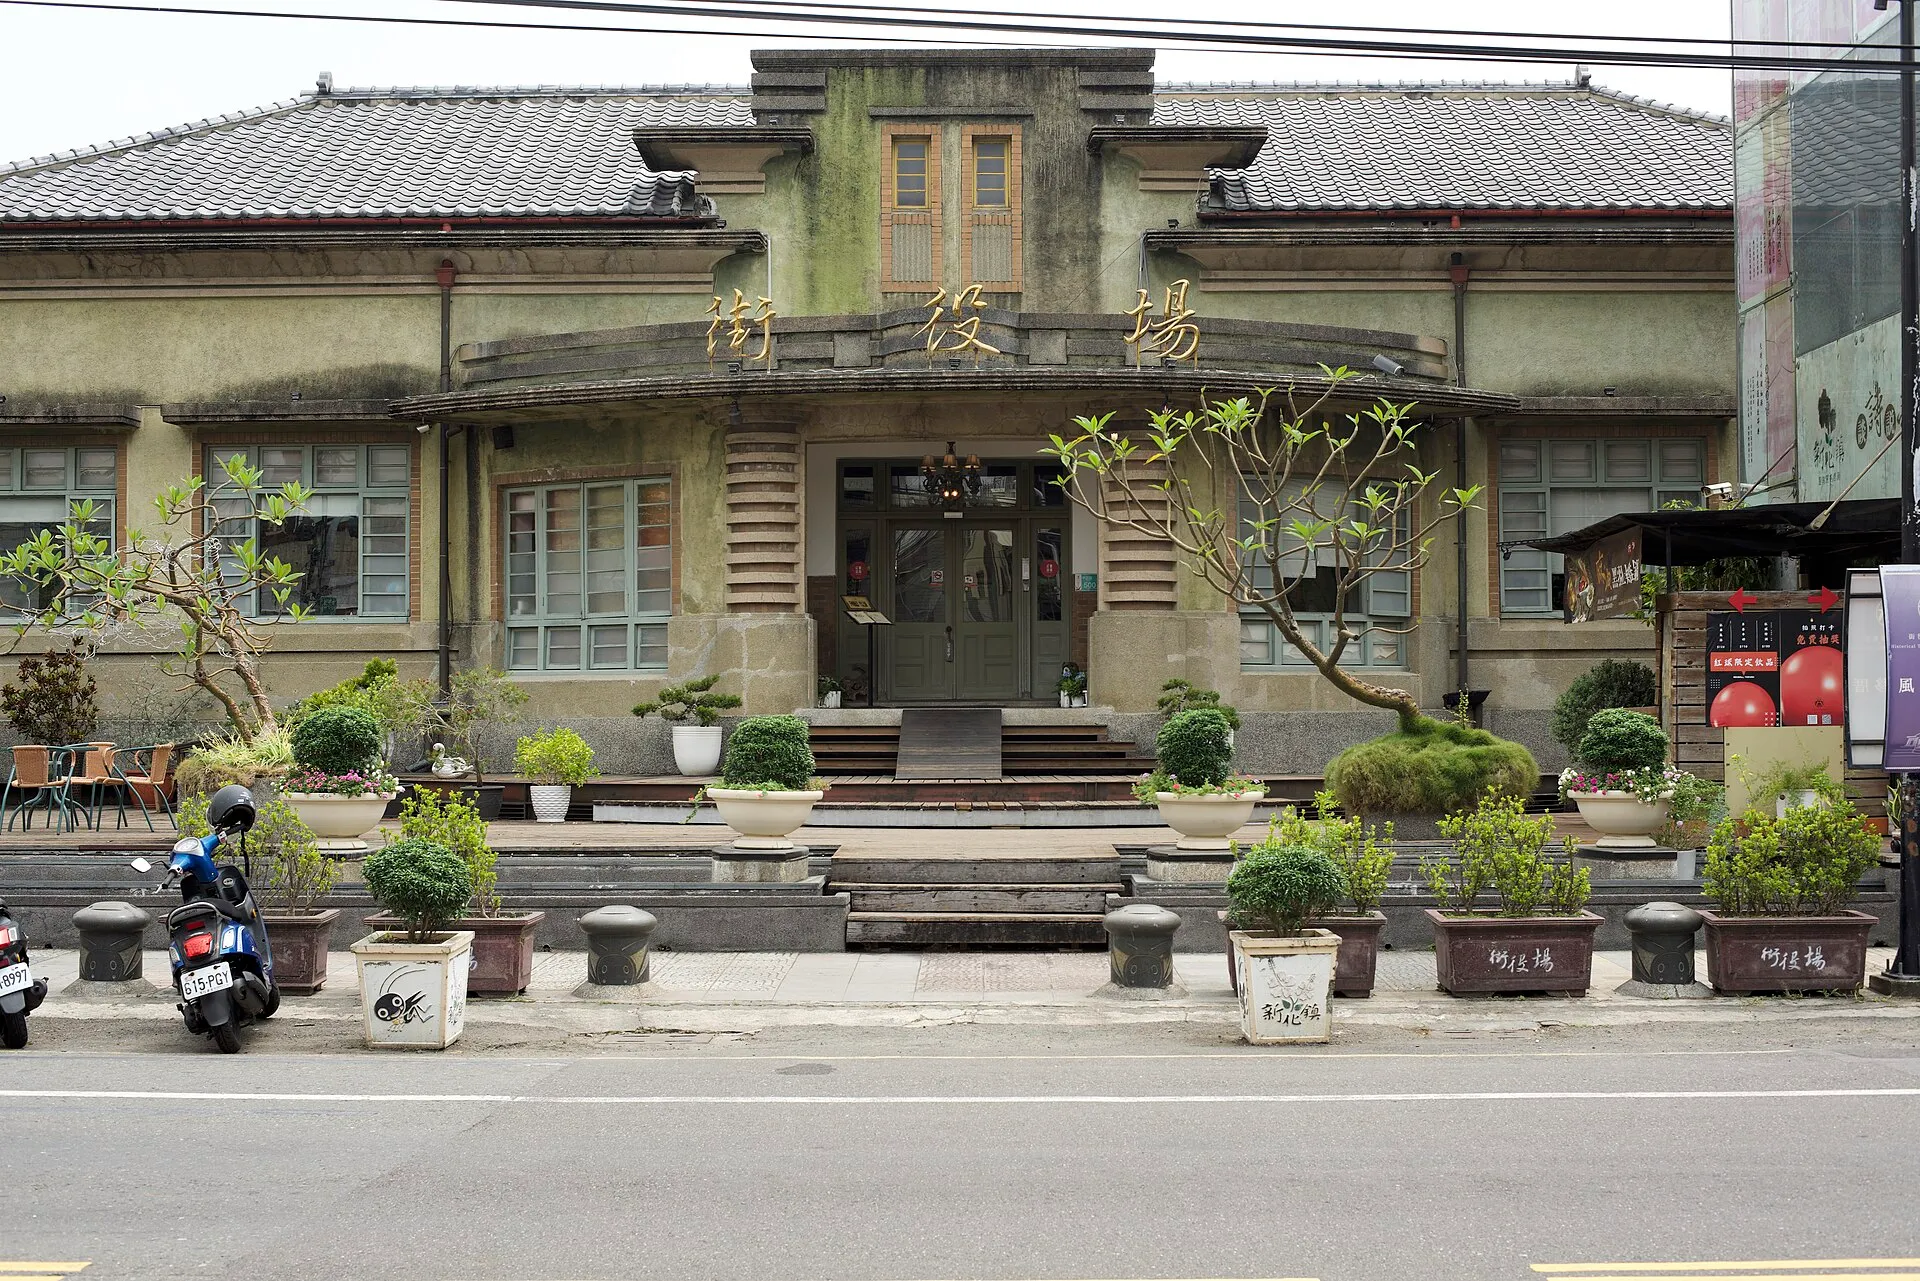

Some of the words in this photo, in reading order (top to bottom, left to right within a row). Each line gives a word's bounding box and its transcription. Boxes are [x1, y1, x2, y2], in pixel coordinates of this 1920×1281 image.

[705, 278, 1201, 363] 街役場
[1796, 633, 1840, 645] 免費抽獎
[1713, 658, 1774, 667] 紅球限定飲品
[1898, 677, 1915, 694] 風
[1489, 947, 1554, 974] 街役場
[1761, 945, 1826, 971] 街役場
[184, 971, 229, 996] 615-PGY
[1261, 1003, 1322, 1026] 新化鎮
